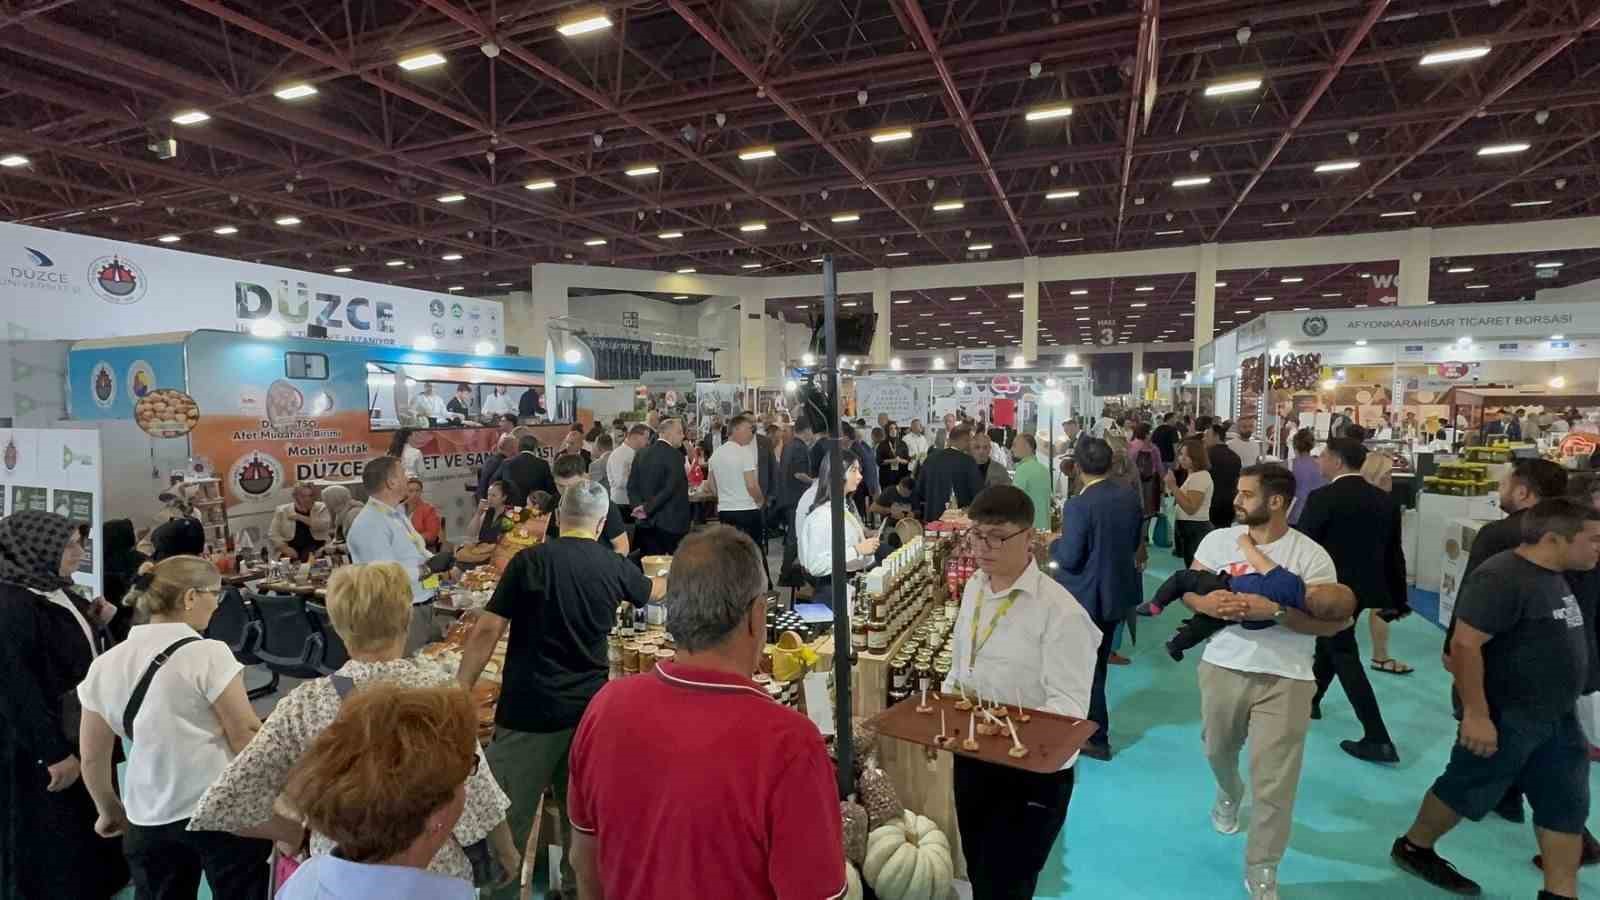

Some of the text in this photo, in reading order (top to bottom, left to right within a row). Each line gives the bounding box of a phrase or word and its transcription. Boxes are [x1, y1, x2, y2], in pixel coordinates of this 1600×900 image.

[235, 279, 395, 333] DÜZCE
[1458, 316, 1511, 328] TİCARET
[1100, 329, 1114, 345] 3
[288, 443, 368, 457] Mobil Mutfak
[297, 459, 363, 480] DÜZCE
[444, 454, 462, 468] VE
